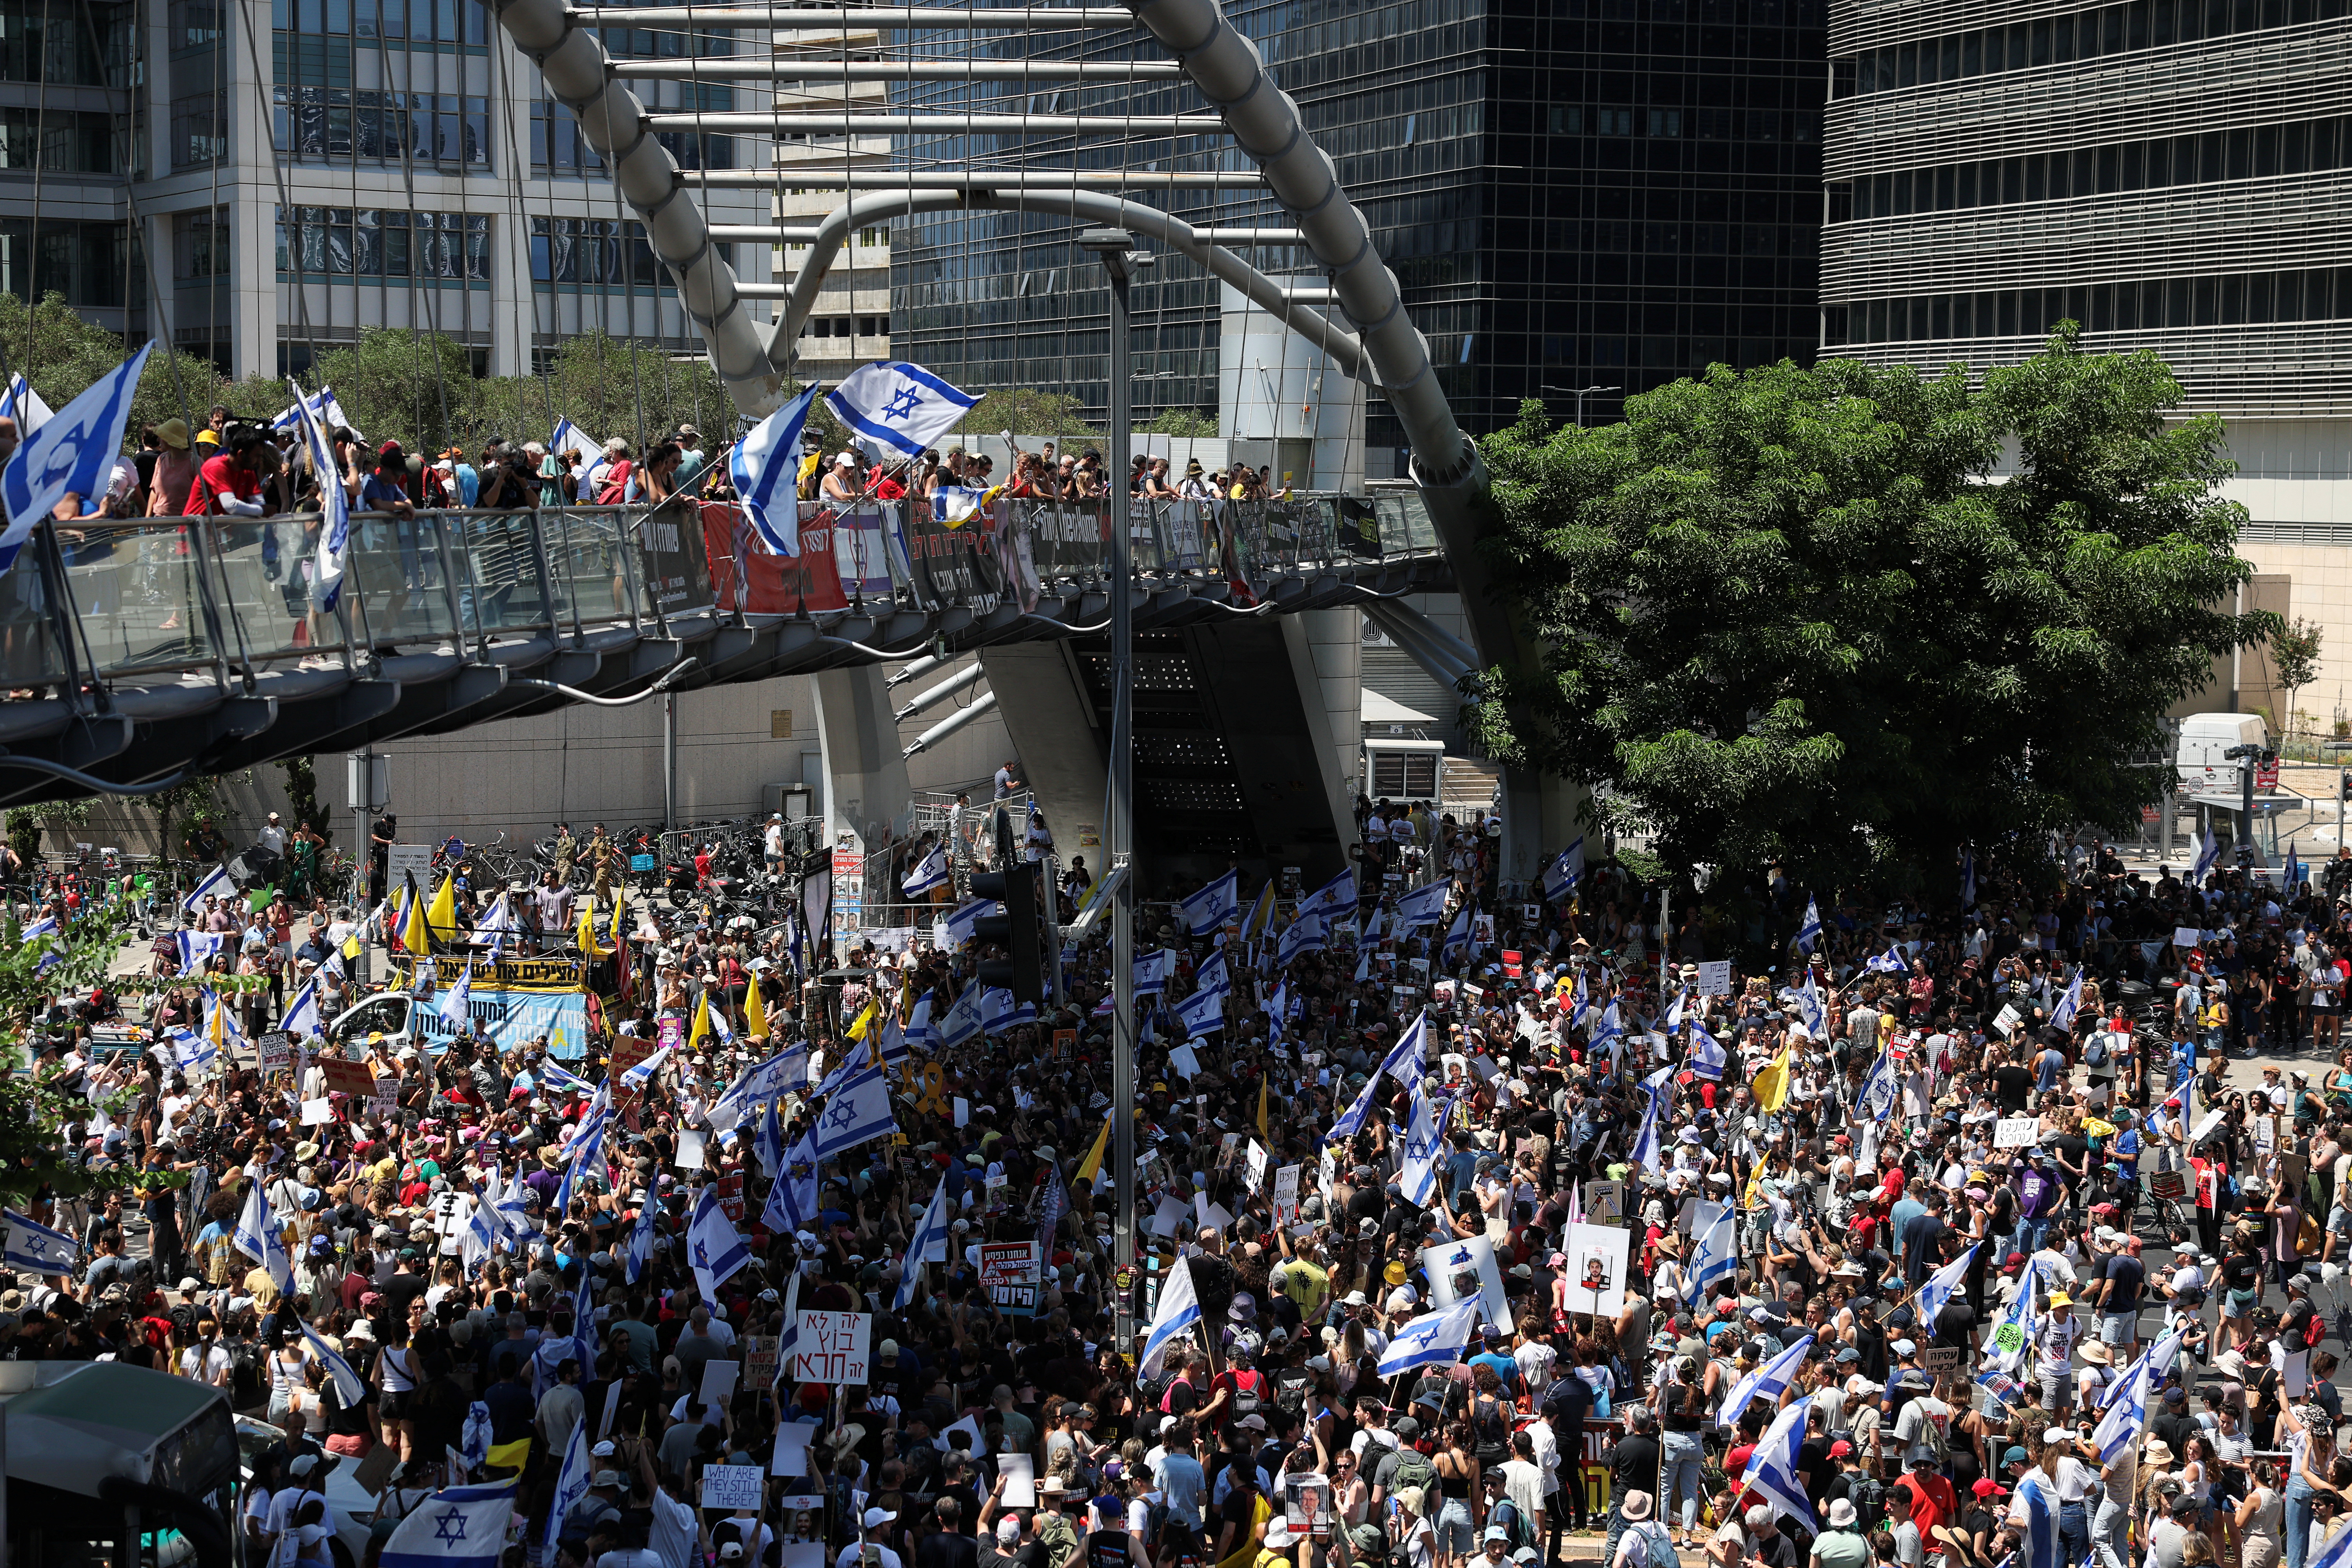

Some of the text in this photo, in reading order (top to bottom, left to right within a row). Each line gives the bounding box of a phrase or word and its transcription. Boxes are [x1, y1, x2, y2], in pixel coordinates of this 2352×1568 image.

[1077, 506, 1099, 543] Home
[1523, 903, 1540, 920] כן
[499, 964, 519, 979] את
[523, 962, 579, 981] מצילים
[2001, 1121, 2033, 1133] נתניהו
[1258, 1149, 1263, 1167] די
[1279, 1171, 1297, 1184] רוצים
[1320, 1157, 1334, 1192] הביתה
[1276, 1187, 1296, 1202] אותם
[984, 1249, 1027, 1261] אנחנו כפסע
[1014, 1260, 1040, 1269] מחיסול
[980, 1278, 1004, 1286] סכנה!
[993, 1285, 1034, 1306] היום!
[806, 1312, 860, 1330] זה לא
[818, 1328, 855, 1354] בוץ
[1930, 1351, 1958, 1362] עסקה
[797, 1353, 864, 1382] זה חרא
[1926, 1363, 1957, 1373] עכשיו!
[708, 1465, 756, 1479] WHY ARE
[704, 1479, 762, 1494] THEY STILL
[715, 1492, 755, 1506] THERE?
